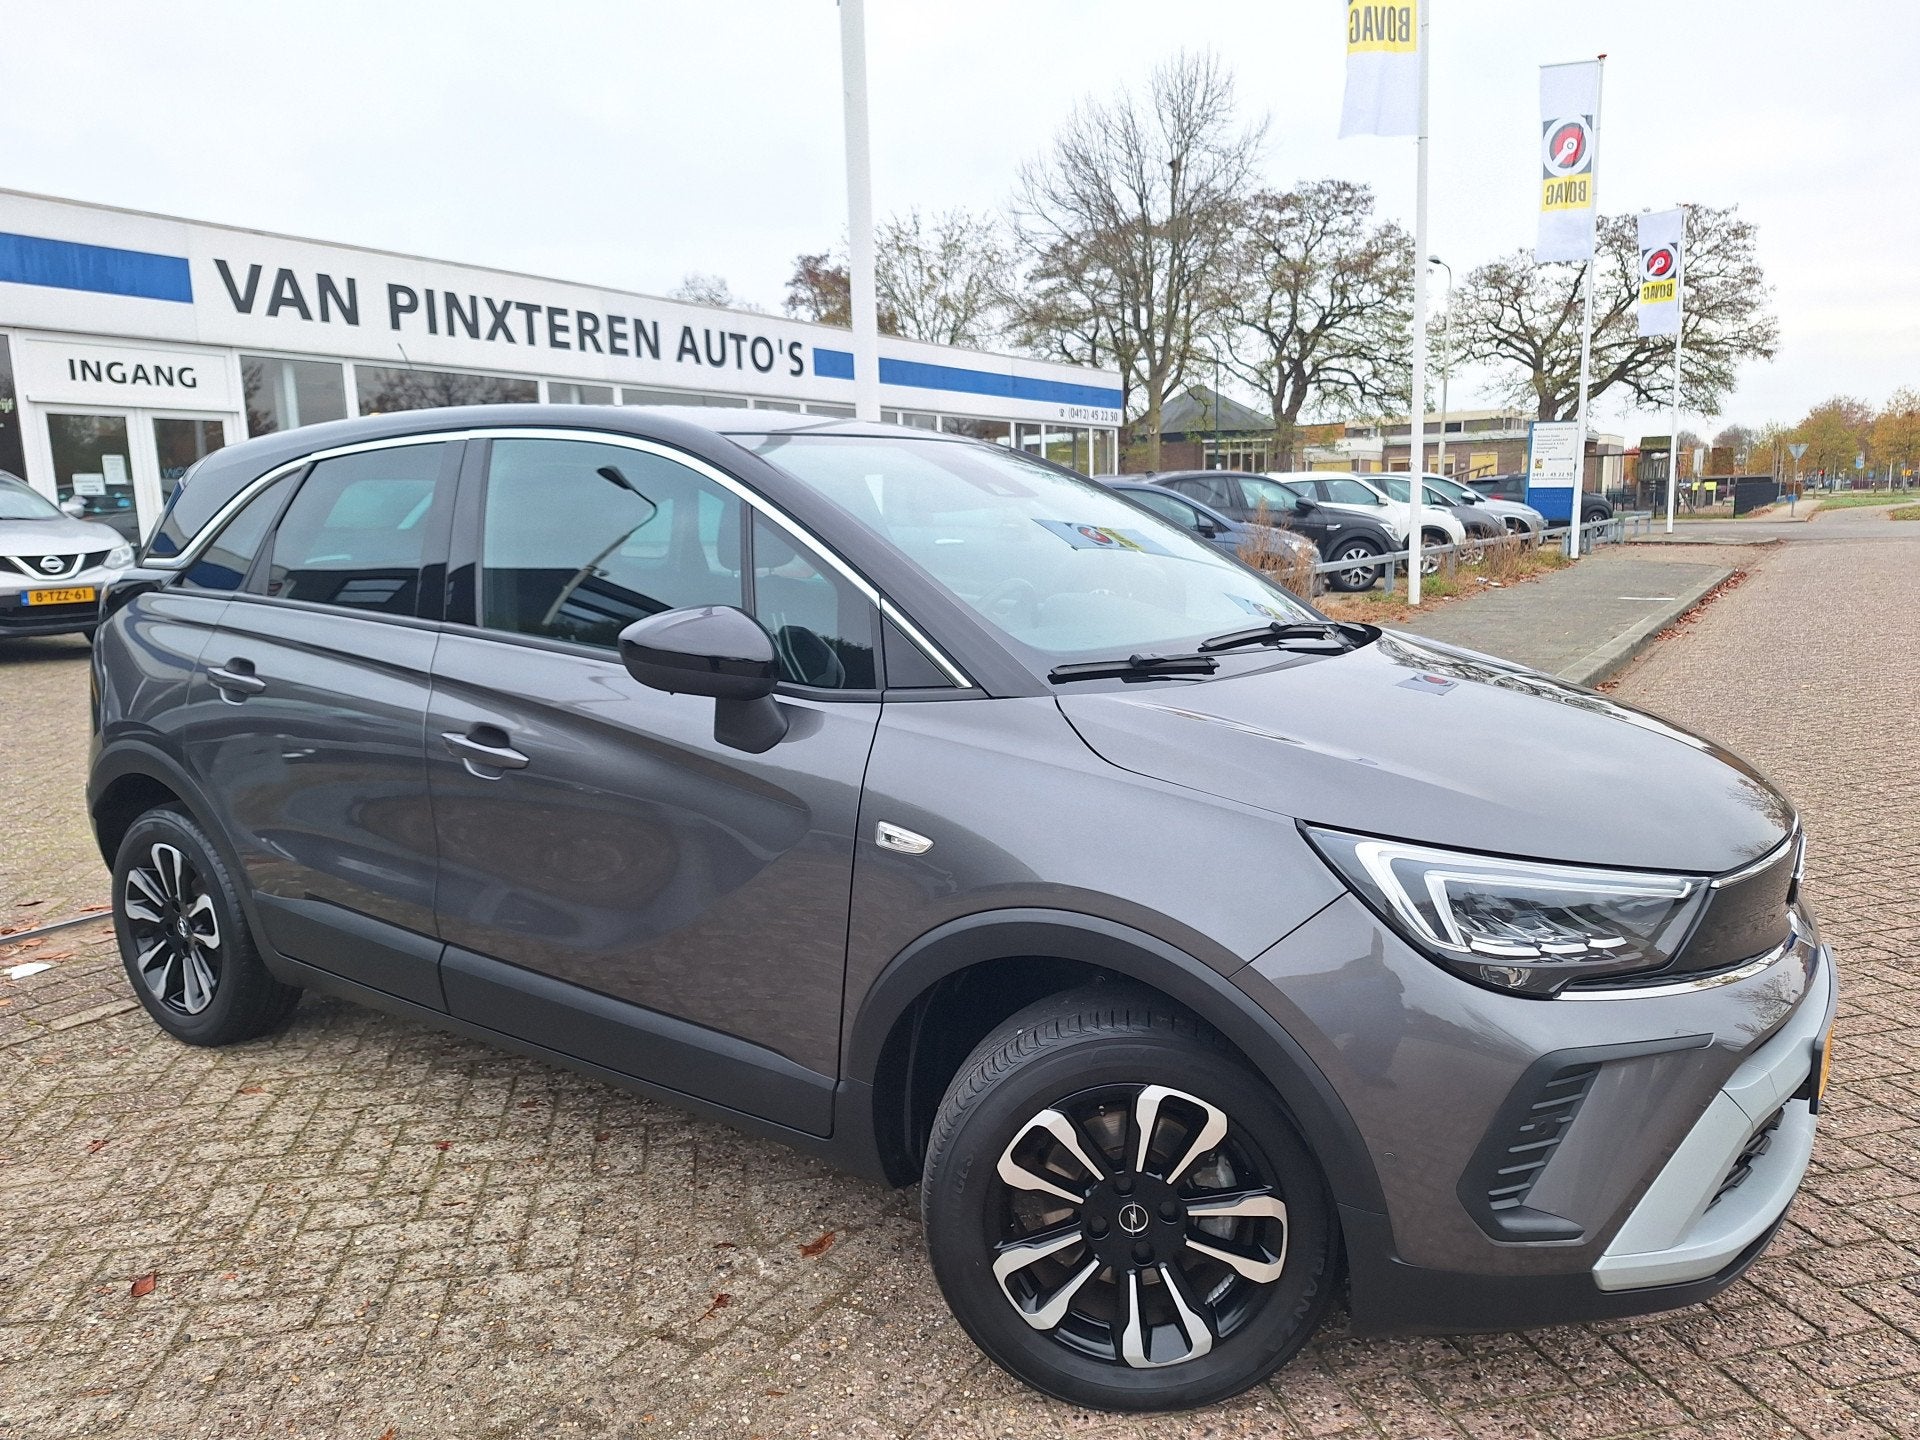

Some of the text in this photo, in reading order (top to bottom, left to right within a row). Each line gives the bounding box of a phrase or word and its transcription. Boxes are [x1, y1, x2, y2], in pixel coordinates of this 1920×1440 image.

[213, 258, 804, 377] VAN PINXTEREN AUTO'S
[68, 358, 197, 389] INGANG
[1069, 407, 1118, 422] (0412) 45 22 50
